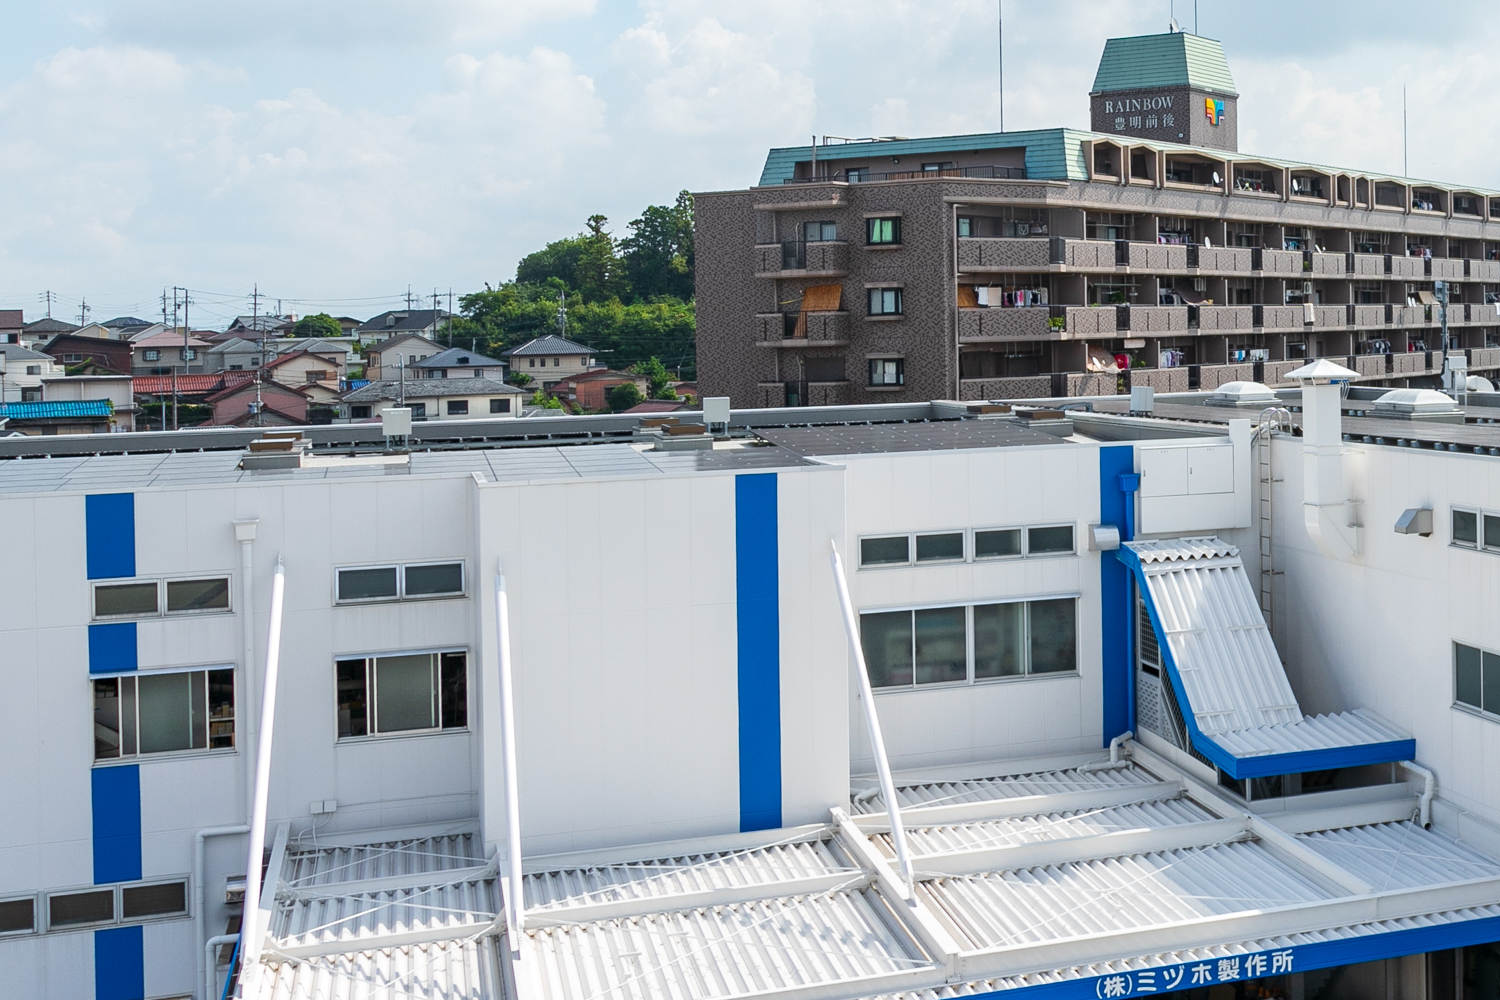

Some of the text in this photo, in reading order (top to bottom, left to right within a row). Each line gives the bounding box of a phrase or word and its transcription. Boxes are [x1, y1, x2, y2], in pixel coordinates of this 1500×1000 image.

[1105, 96, 1174, 114] RAINBOW
[1114, 113, 1175, 131] 豊明前後
[1095, 949, 1294, 1000] (株)ミヅホ製作所
